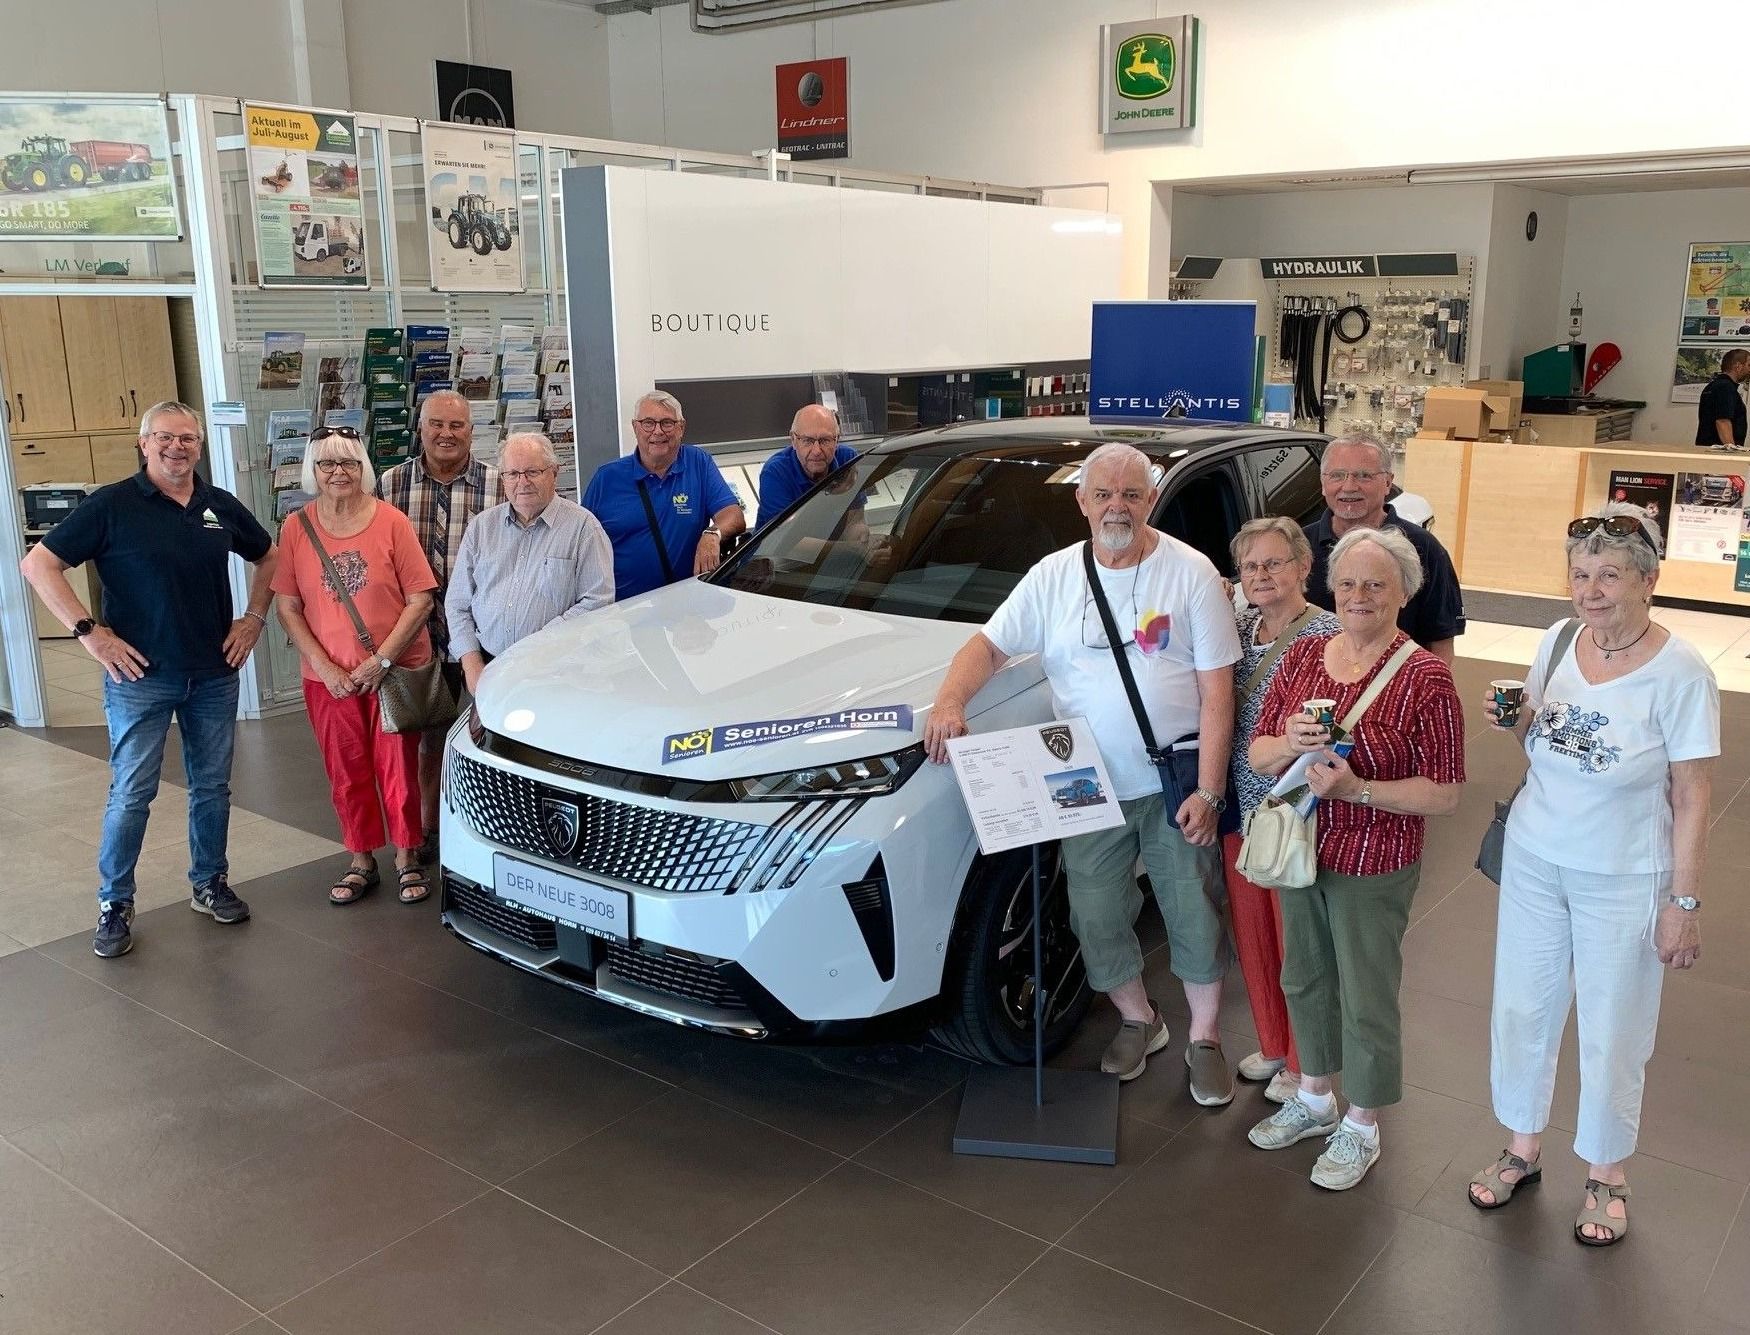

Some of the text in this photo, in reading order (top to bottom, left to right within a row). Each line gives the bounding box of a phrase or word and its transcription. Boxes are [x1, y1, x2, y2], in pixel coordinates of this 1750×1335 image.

[1114, 107, 1175, 120] JOHN DEERE
[251, 116, 301, 129] Aktuell im
[780, 116, 845, 129] Lindner
[252, 127, 310, 141] Juli-August
[32, 200, 71, 218] 185
[14, 220, 47, 231] SMART,
[63, 220, 90, 230] MORE
[45, 258, 70, 272] LM
[1273, 260, 1365, 275] HYDRAULIK
[651, 313, 770, 334] BOUTIQUE
[1098, 396, 1241, 409] STELLANTIS
[1615, 475, 1629, 483] MAN
[724, 711, 898, 742] Senioren Horn
[669, 731, 706, 754] NÖ
[670, 749, 705, 760] Senioren
[544, 802, 576, 814] PEUGEOT
[507, 872, 615, 919] DER NEUE 3008
[522, 905, 556, 922] AUTOHAUS
[558, 918, 578, 929] HORN
